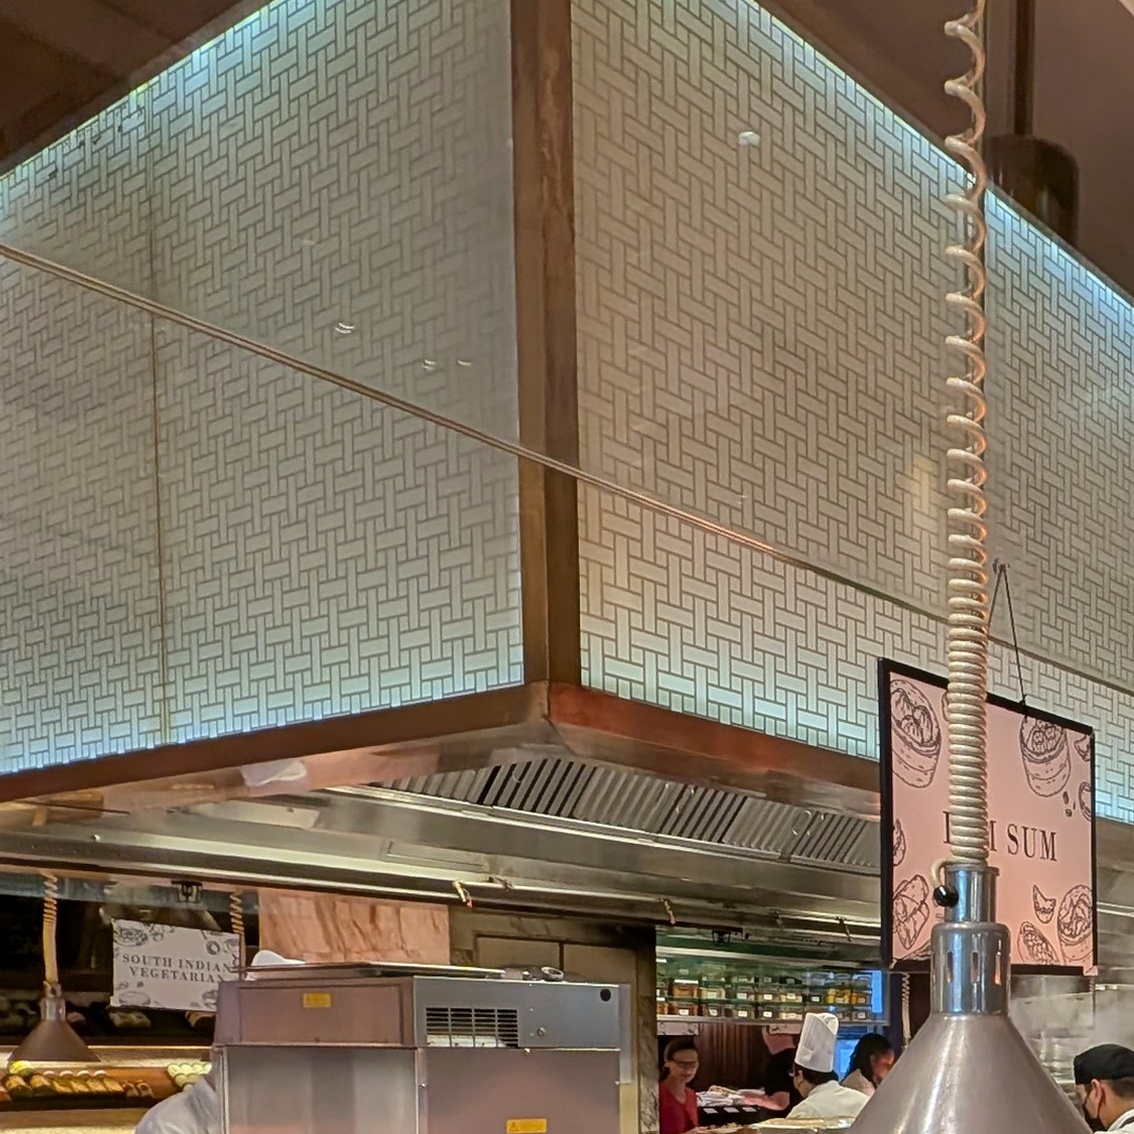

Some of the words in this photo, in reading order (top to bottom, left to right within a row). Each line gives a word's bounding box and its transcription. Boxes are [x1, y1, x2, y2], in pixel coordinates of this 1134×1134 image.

[1007, 823, 1058, 861] SUM
[122, 954, 172, 968] SOUTH
[178, 958, 232, 972] INDIAN
